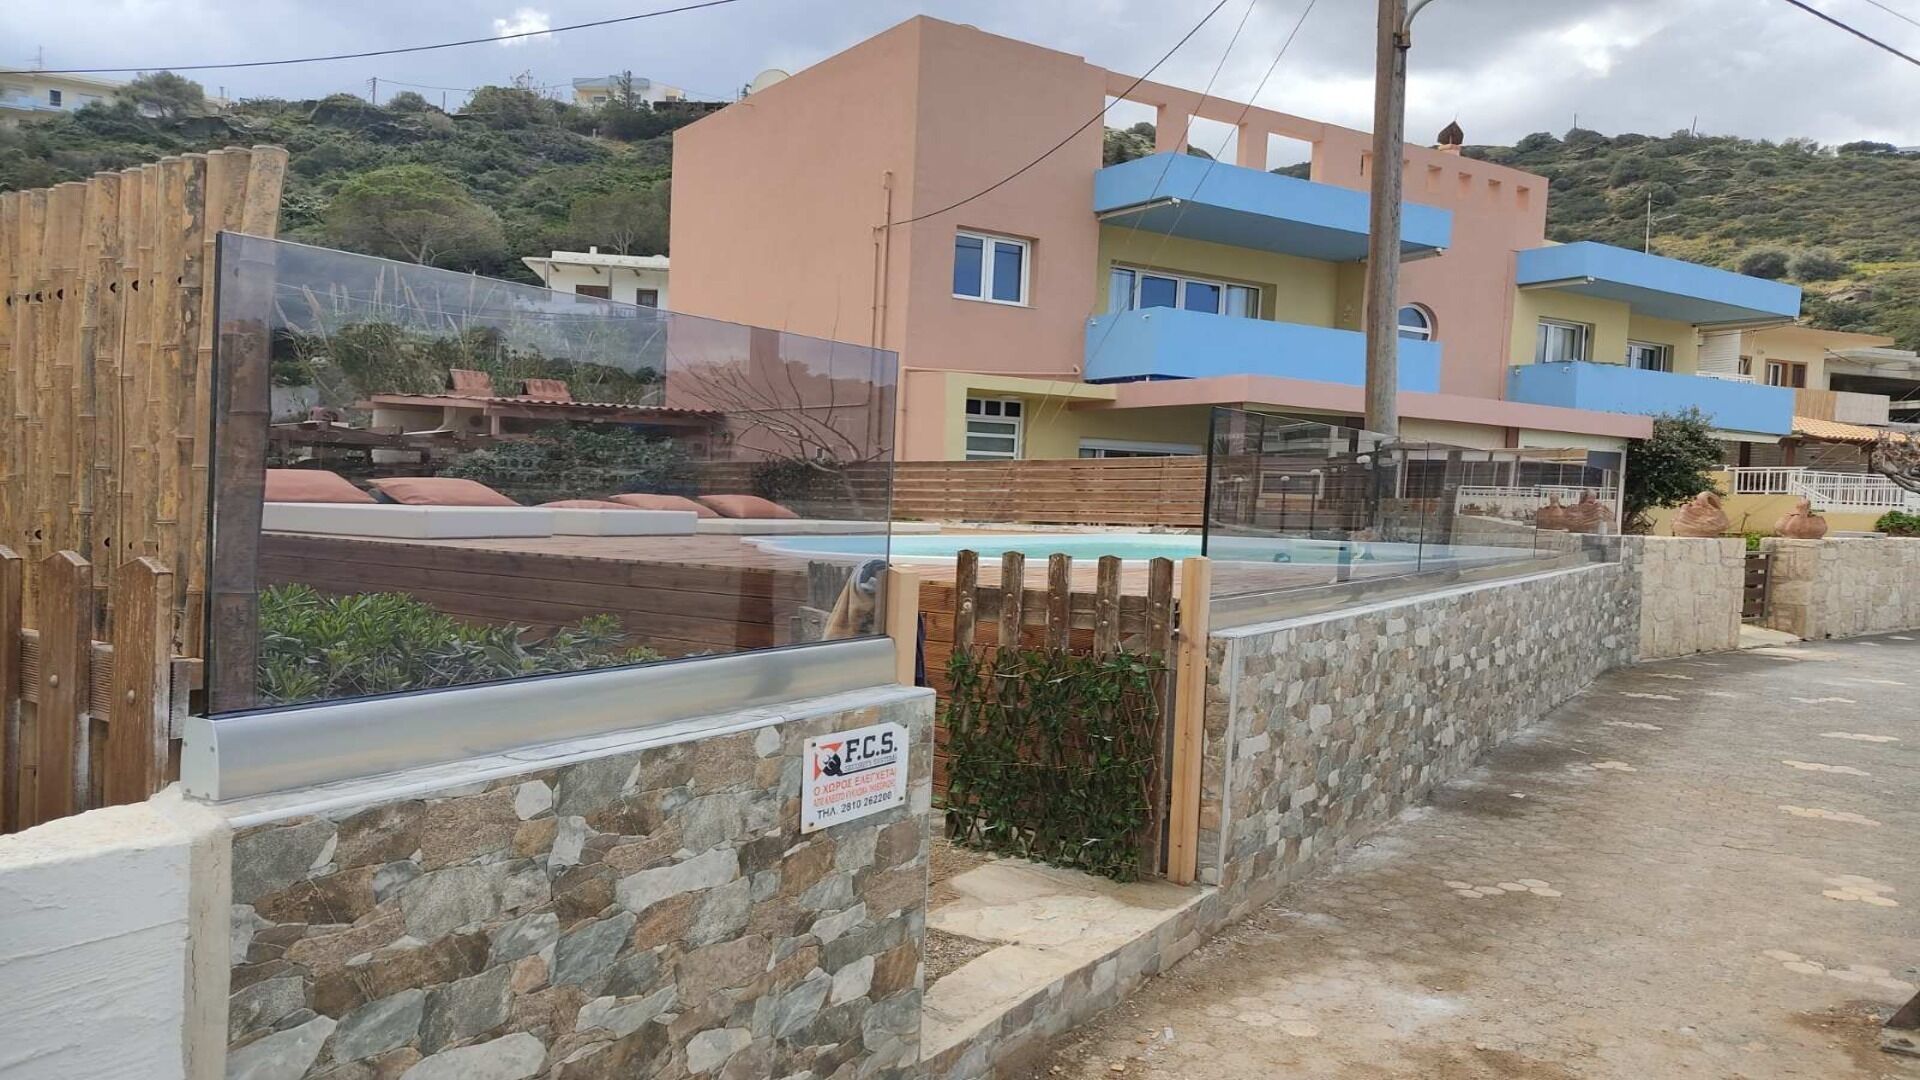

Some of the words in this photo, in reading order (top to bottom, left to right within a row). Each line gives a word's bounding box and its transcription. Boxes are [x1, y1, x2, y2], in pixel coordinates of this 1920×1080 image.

[845, 732, 898, 763] F.C.S.
[841, 800, 862, 813] 2810
[864, 791, 892, 806] 262200
